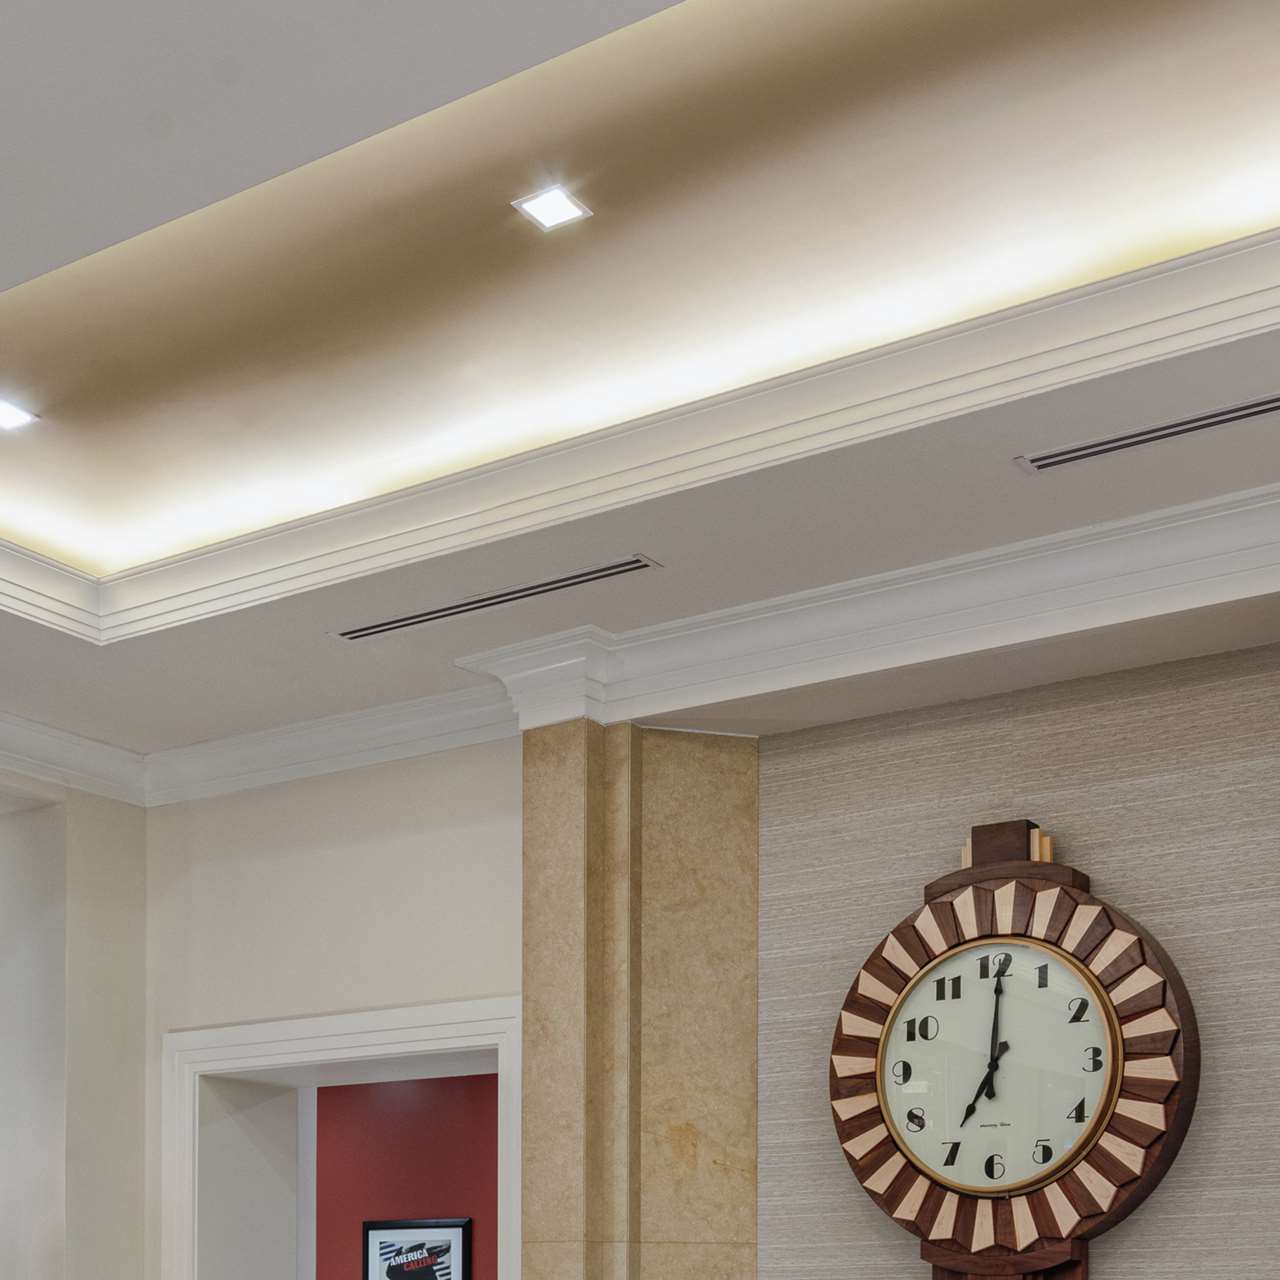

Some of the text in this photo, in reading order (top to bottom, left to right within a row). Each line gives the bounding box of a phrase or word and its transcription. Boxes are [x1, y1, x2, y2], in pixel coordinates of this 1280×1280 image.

[976, 953, 1013, 979] 12
[1034, 963, 1049, 989] 1
[932, 975, 961, 1001] 11
[1068, 997, 1090, 1024] 2
[903, 1015, 939, 1041] 10
[892, 1060, 912, 1086] 9
[1082, 1047, 1103, 1073] 3
[906, 1107, 926, 1133] 8
[1066, 1097, 1089, 1123] 4
[941, 1141, 961, 1167] 7
[1032, 1138, 1053, 1165] 5
[984, 1154, 1006, 1180] 6
[390, 1248, 429, 1267] AMERICA
